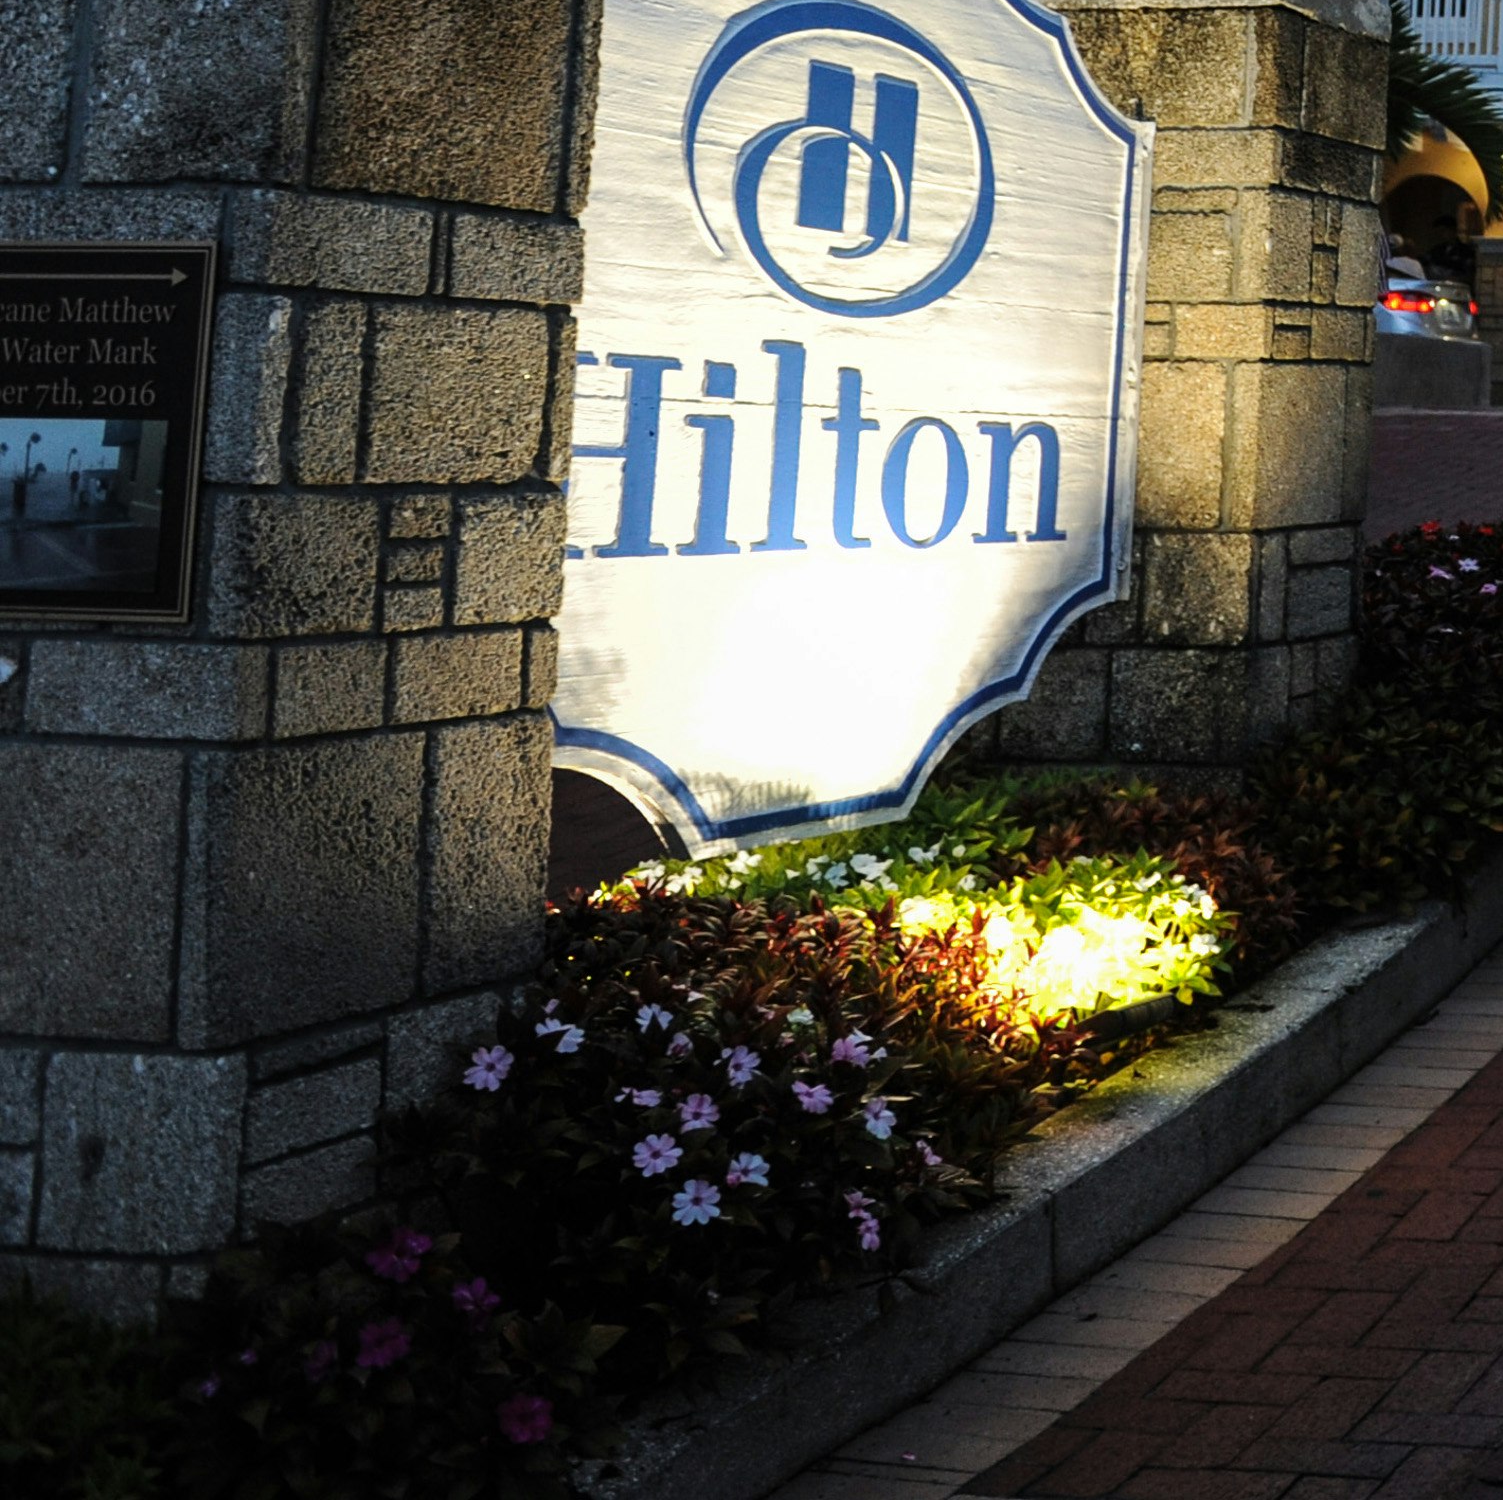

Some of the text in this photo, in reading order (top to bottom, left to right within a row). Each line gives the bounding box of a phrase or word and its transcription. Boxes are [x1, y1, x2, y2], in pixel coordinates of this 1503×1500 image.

[58, 295, 176, 324] Matthew
[2, 337, 157, 364] Water Mark
[36, 377, 83, 410] 7th,
[92, 380, 156, 406] 2016
[562, 339, 1067, 560] Hilton
